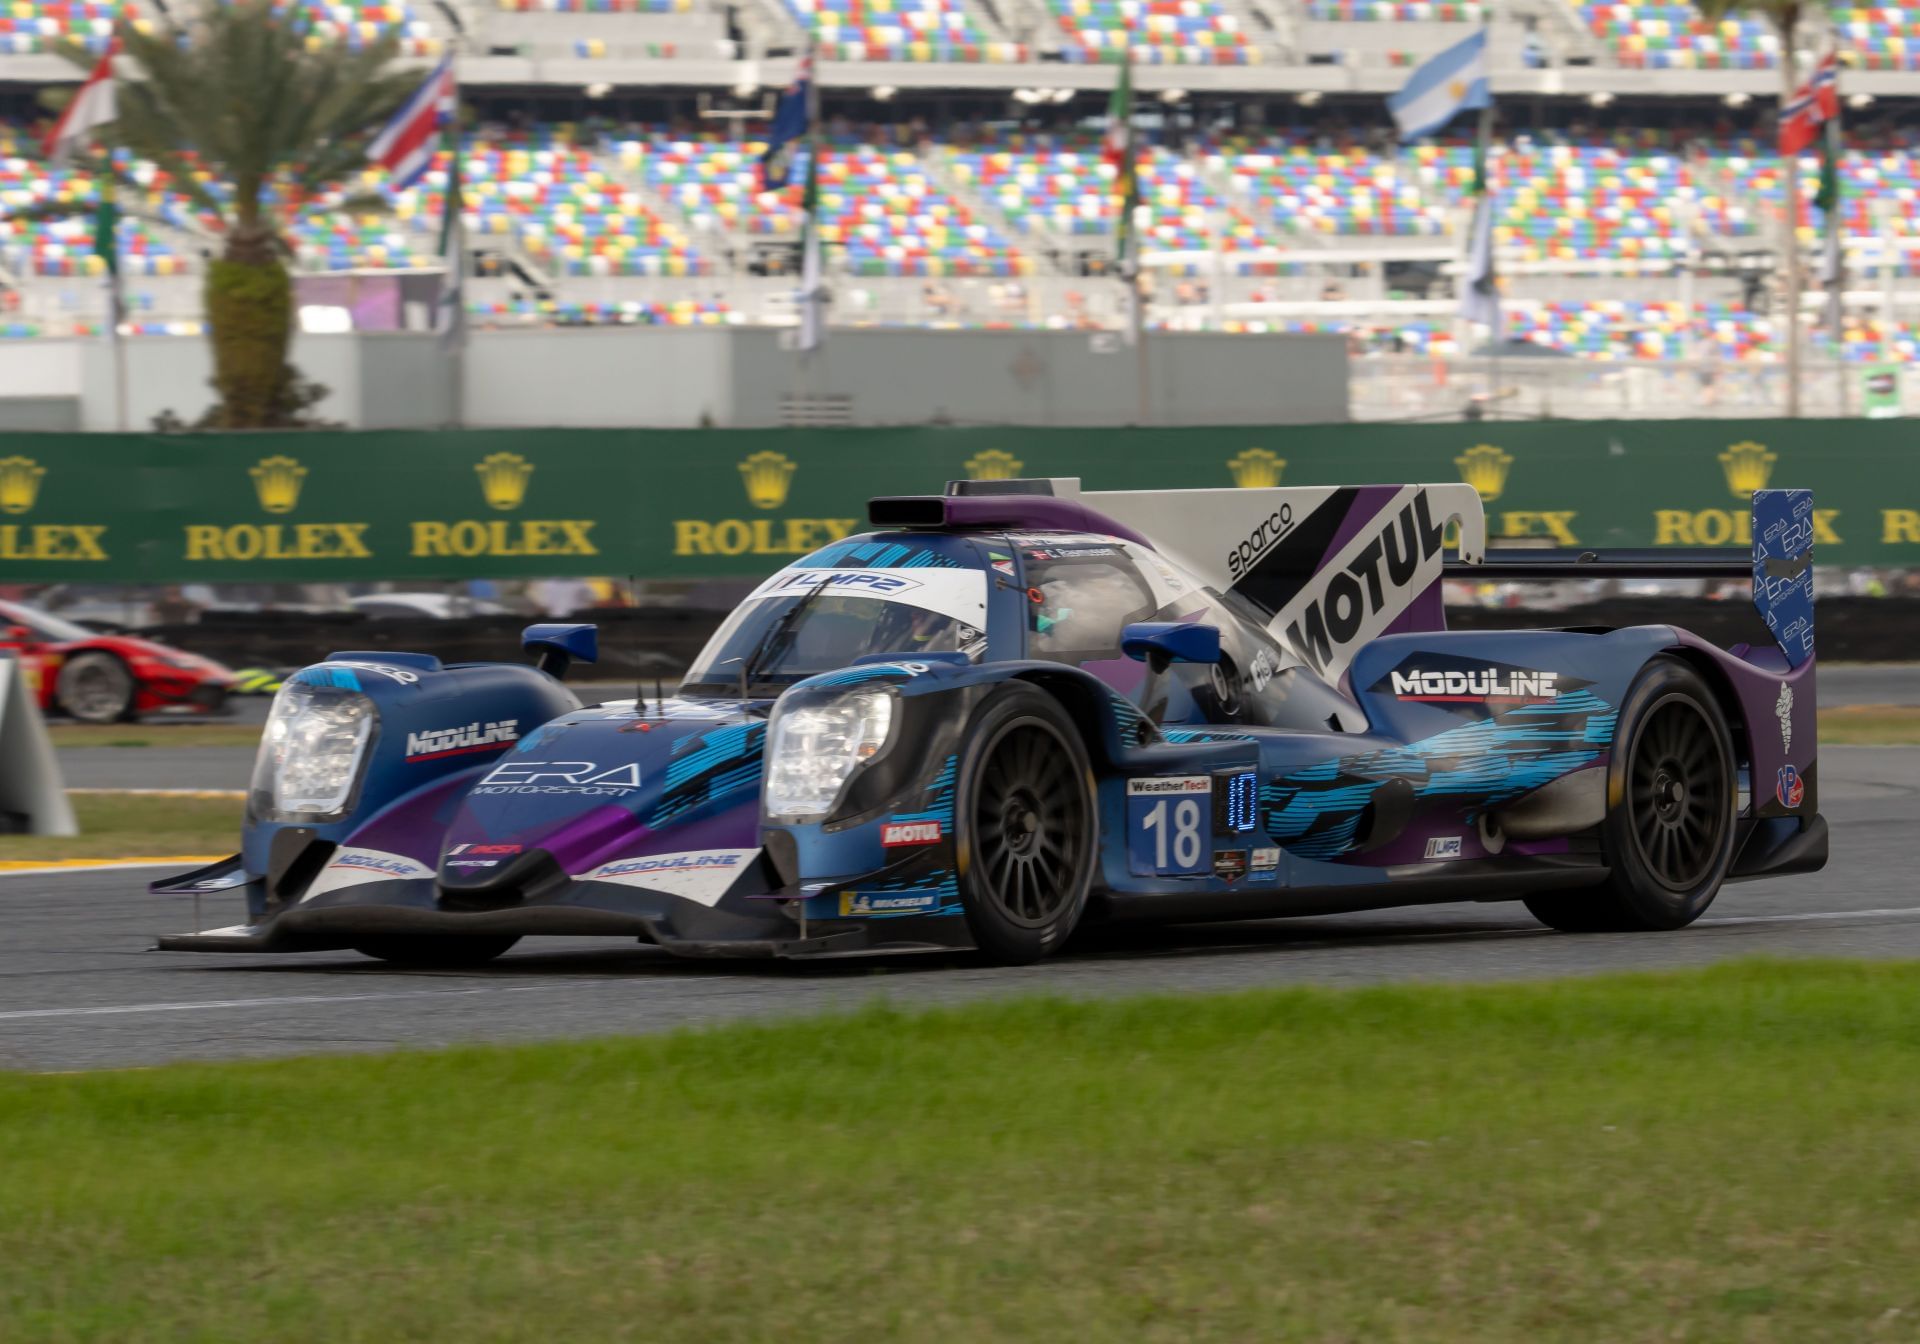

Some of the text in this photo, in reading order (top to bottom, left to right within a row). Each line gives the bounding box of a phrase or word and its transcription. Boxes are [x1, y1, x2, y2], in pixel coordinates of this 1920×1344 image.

[0, 525, 109, 560] LEX
[183, 523, 373, 560] ROLEX
[409, 520, 599, 556] ROLEX
[1228, 502, 1292, 575] sparco
[1653, 509, 1843, 545] ROLX
[1764, 518, 1787, 541] ERA
[1782, 517, 1814, 552] ERA
[796, 573, 907, 591] LMP2
[1285, 488, 1443, 677] MOTUL
[1783, 616, 1807, 640] ERA
[1391, 668, 1558, 697] MODULINE
[405, 719, 520, 756] MODULINE
[479, 761, 641, 787] ERA
[1131, 780, 1209, 792] WeatherTech
[466, 785, 638, 797] MOTORSPORT
[884, 823, 940, 843] MOTUL
[1142, 800, 1202, 868] 18
[597, 854, 742, 876] MODULINE
